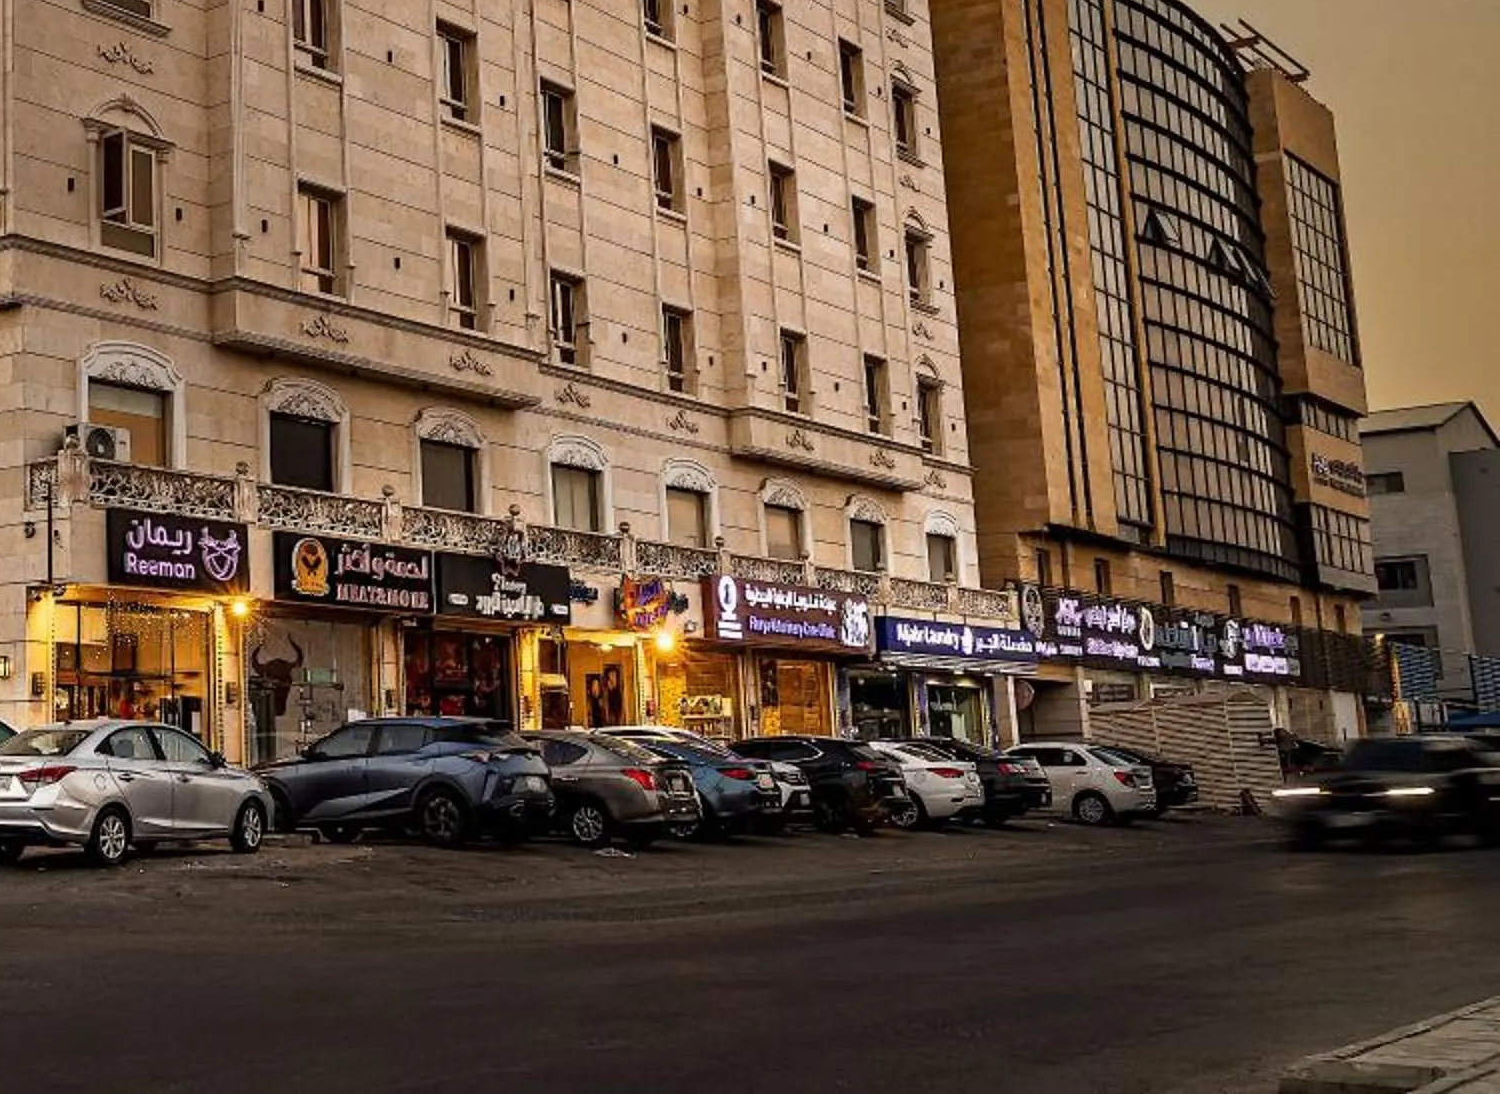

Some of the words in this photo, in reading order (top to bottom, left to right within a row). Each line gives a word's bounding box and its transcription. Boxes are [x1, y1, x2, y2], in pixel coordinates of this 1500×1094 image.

[126, 518, 192, 555] ريمان
[124, 552, 196, 580] Reeman
[925, 626, 959, 650] Laundry
[1000, 634, 1033, 653] مغسلة
